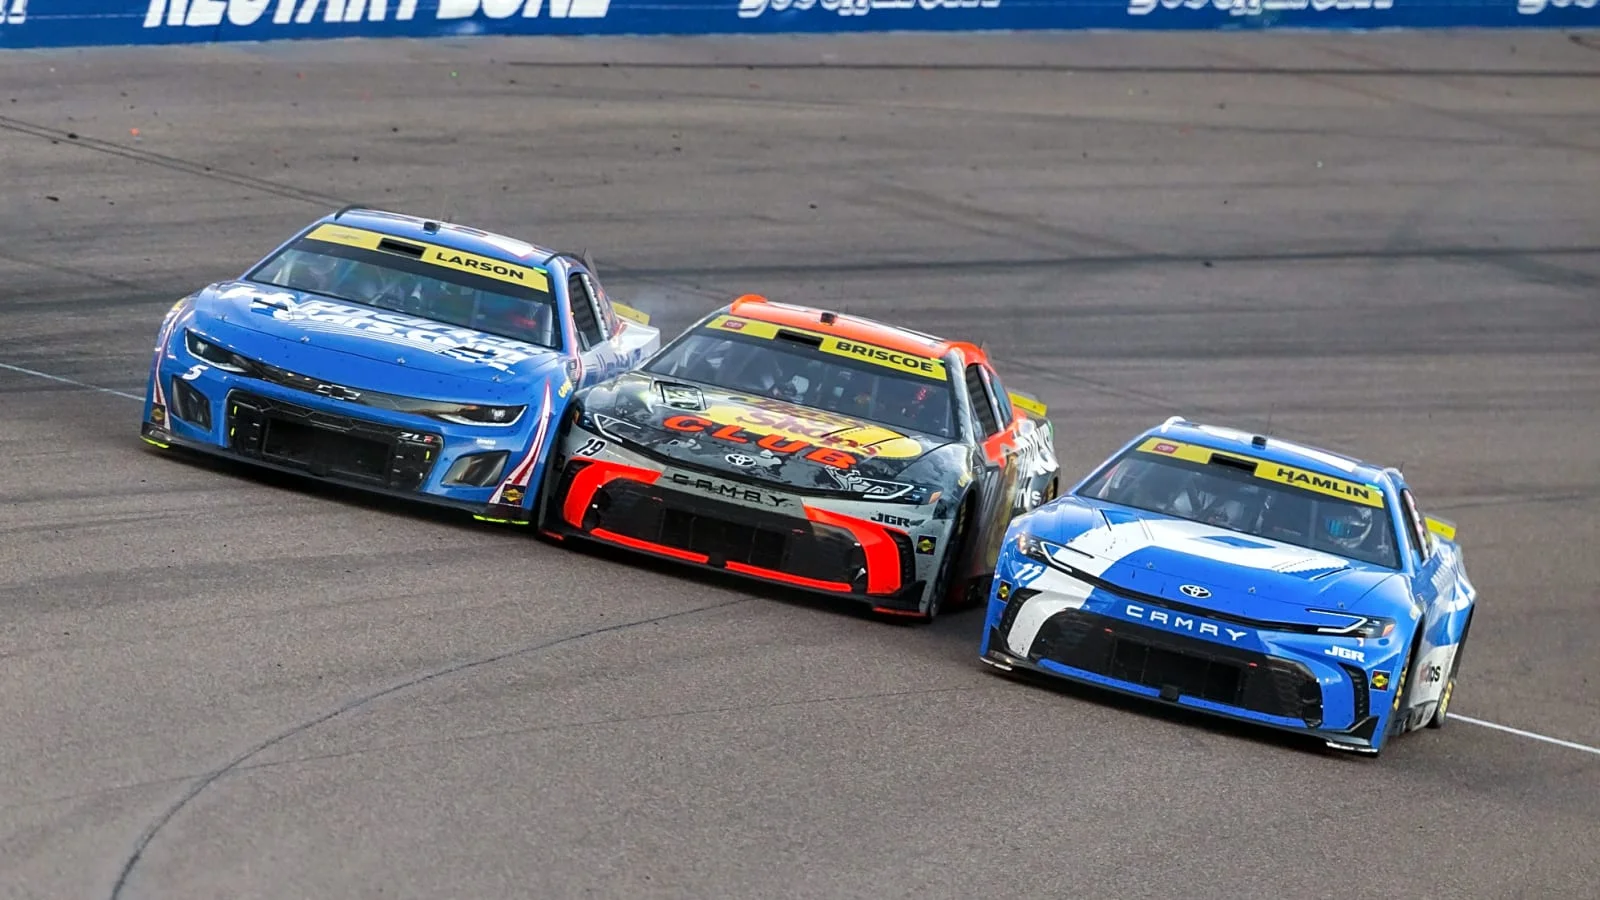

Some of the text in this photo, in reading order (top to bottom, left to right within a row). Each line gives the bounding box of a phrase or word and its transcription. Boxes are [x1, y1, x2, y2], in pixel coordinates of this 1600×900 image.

[436, 252, 525, 279] LARSON
[835, 341, 933, 372] BRISCOE
[183, 364, 209, 381] 5
[575, 437, 607, 457] 19
[663, 414, 857, 469] CLUB
[672, 473, 789, 506] CAMRY
[1277, 467, 1370, 500] HAMLIN
[870, 513, 910, 527] JGR
[1014, 563, 1042, 580] 11
[1126, 605, 1247, 641] CAMRY
[1324, 645, 1364, 663] JGR
